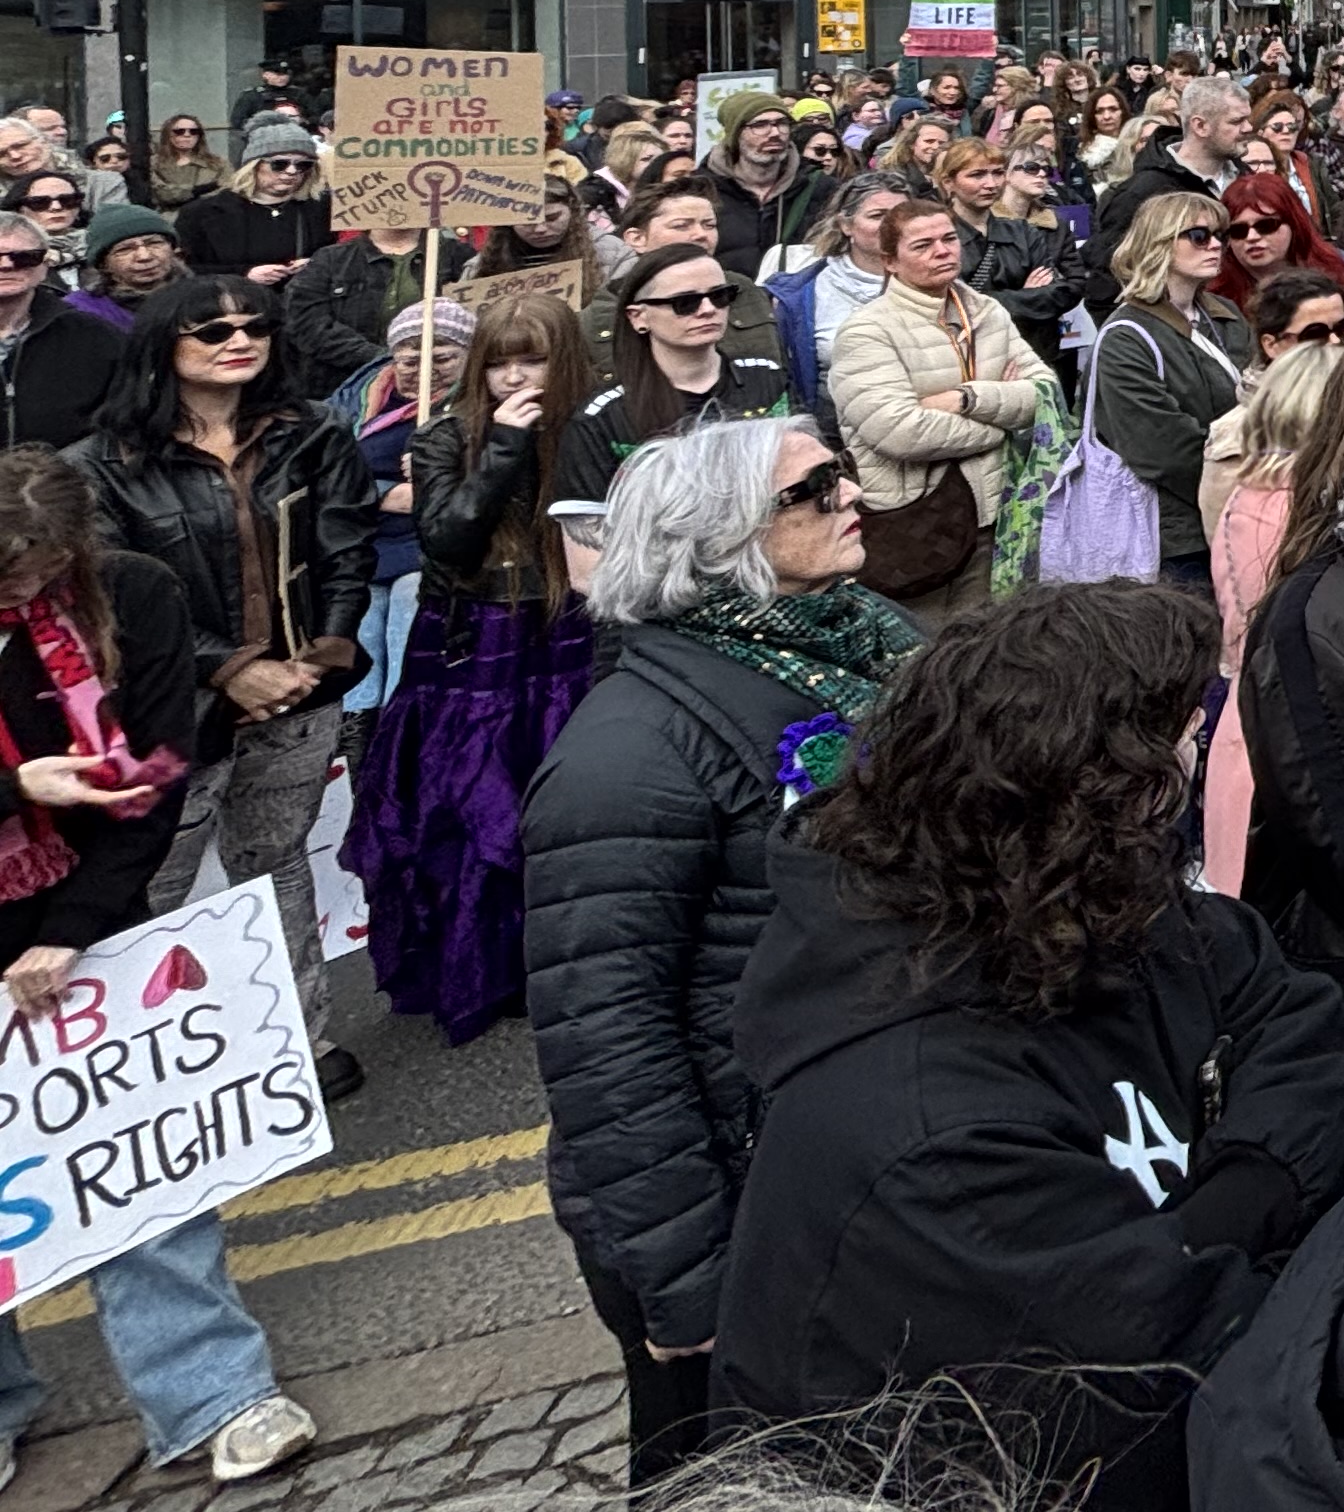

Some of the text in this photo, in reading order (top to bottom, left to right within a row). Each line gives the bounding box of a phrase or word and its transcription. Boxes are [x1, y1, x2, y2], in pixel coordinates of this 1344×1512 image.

[934, 6, 976, 24] LIFE
[334, 171, 388, 206] FUCK
[65, 1061, 314, 1229] RIGHTS
